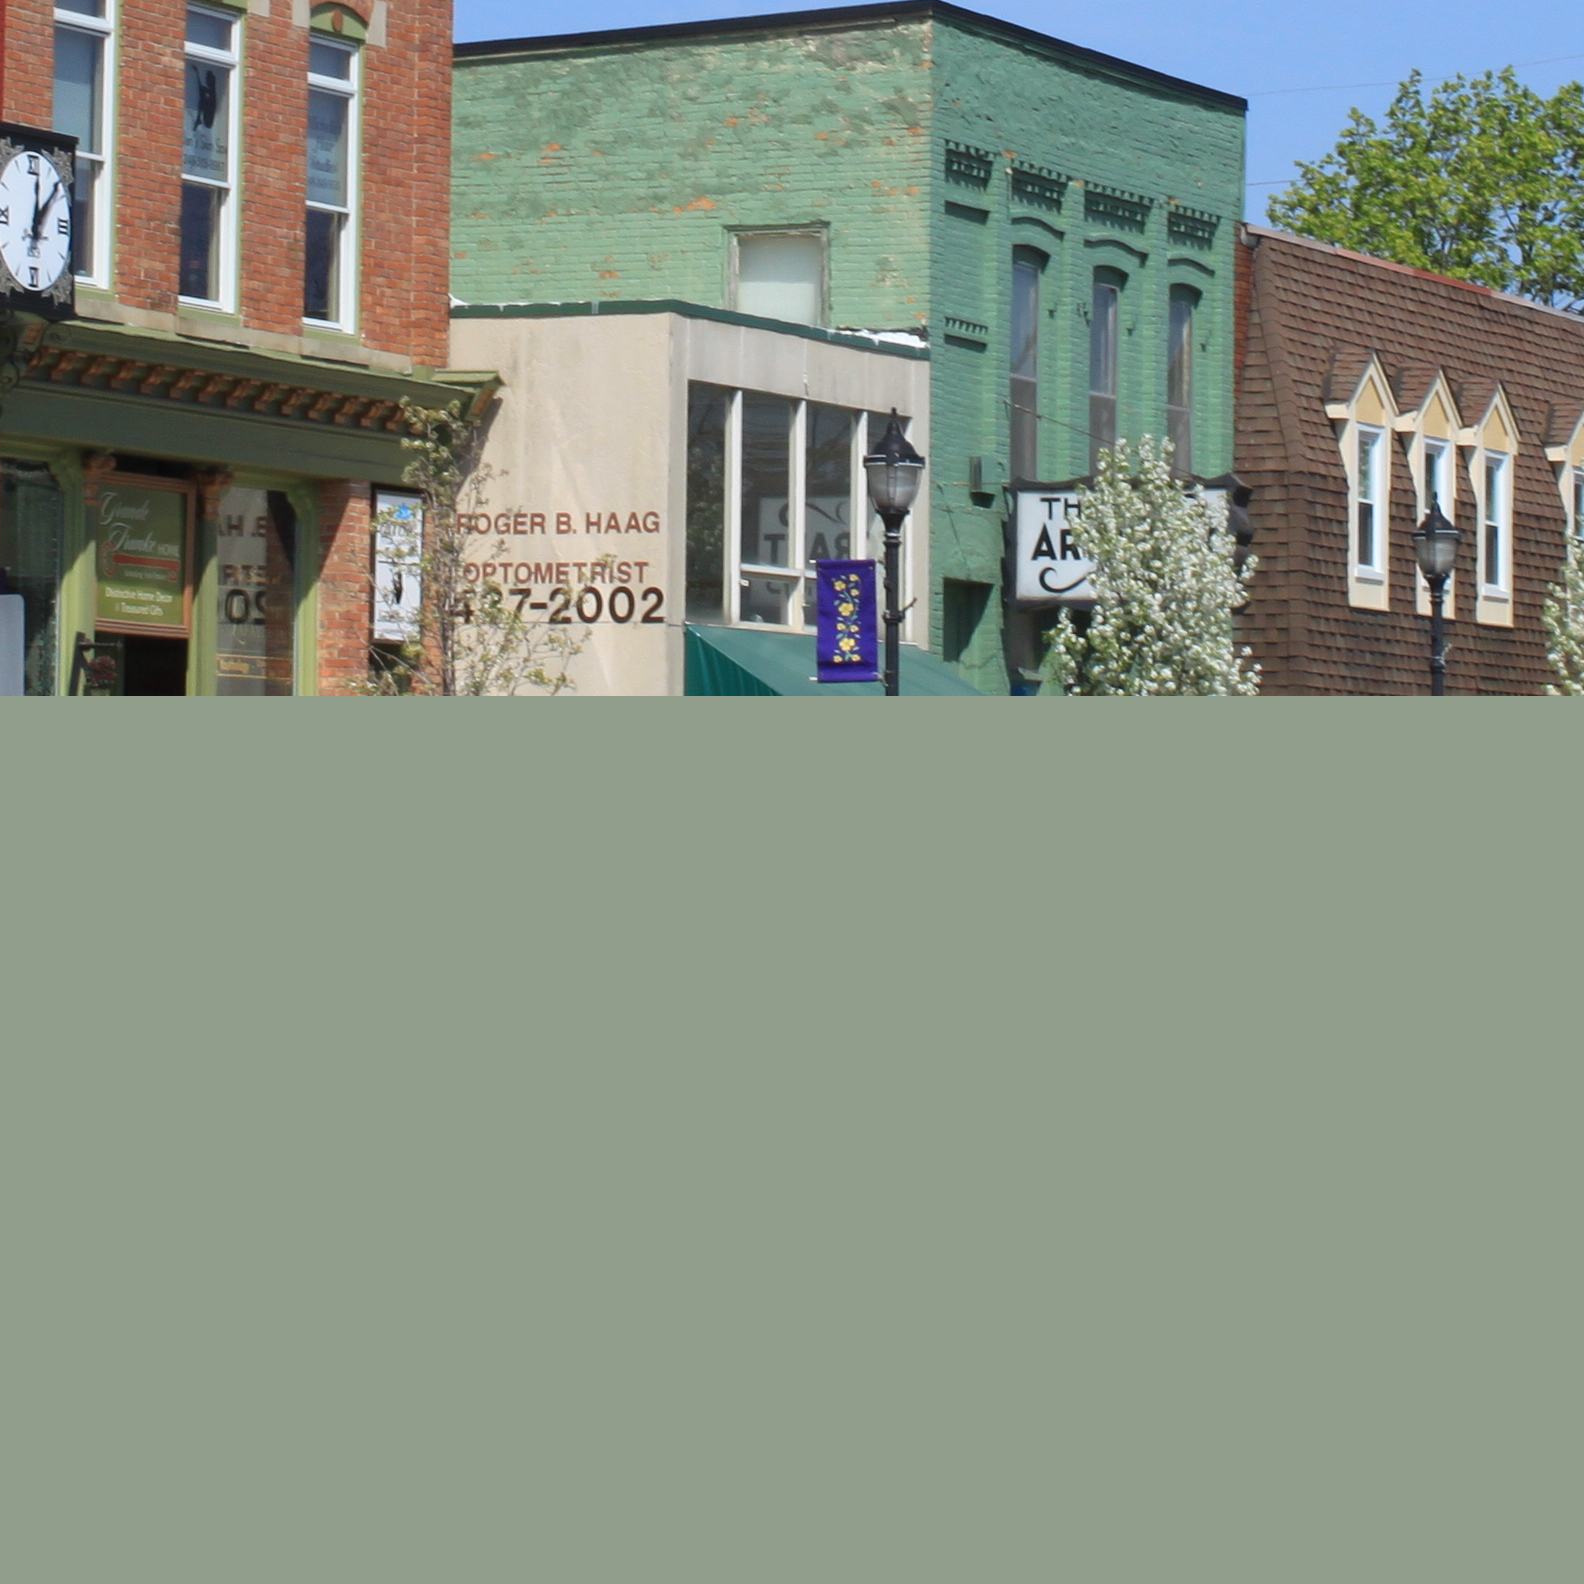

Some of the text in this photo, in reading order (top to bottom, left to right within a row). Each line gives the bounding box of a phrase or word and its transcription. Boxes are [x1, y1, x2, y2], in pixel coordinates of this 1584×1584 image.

[1040, 497, 1081, 520] TH
[456, 511, 661, 534] ROGER B. HAAG
[465, 561, 650, 584] OPTOMETRIST
